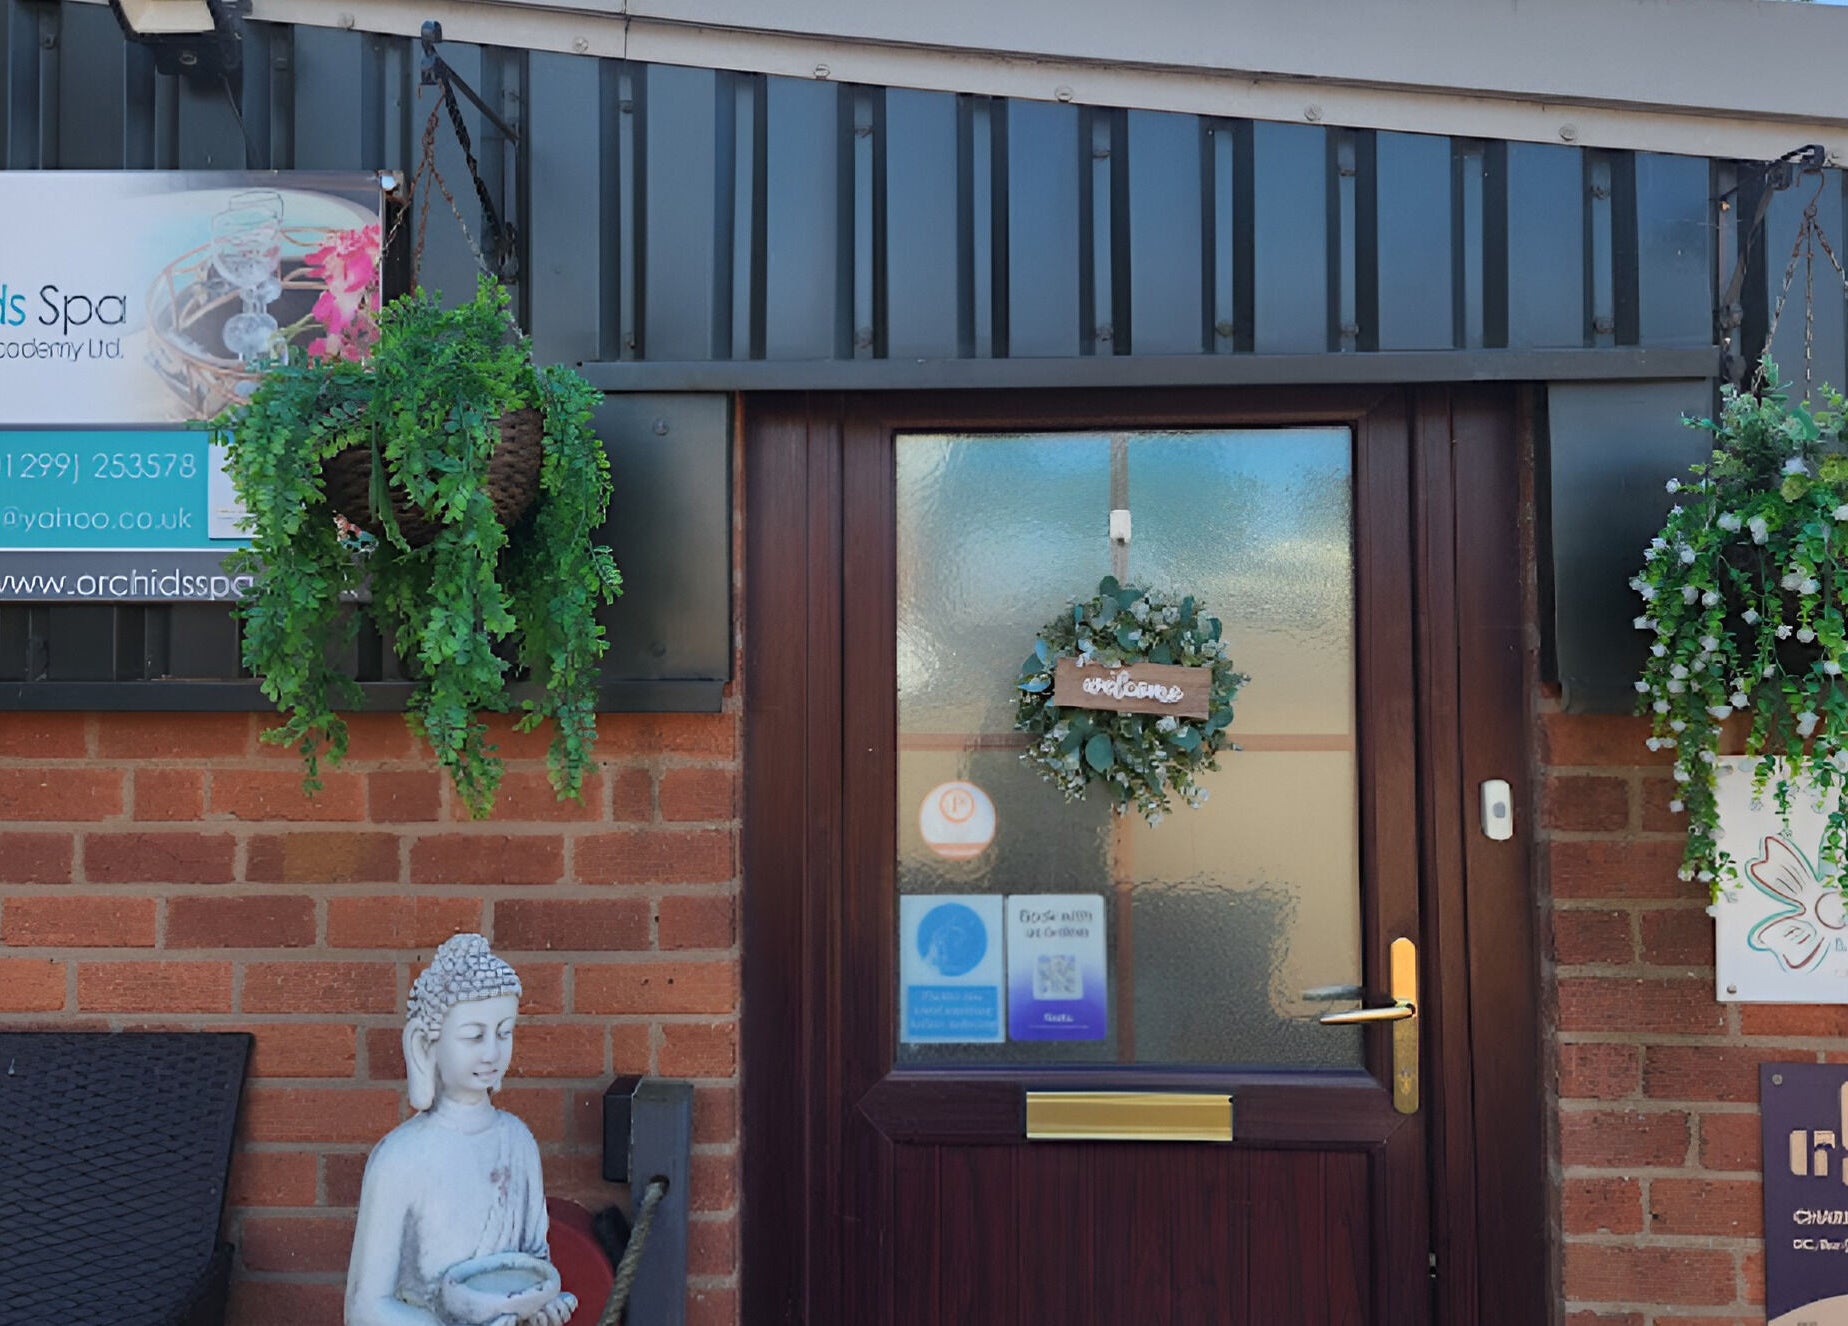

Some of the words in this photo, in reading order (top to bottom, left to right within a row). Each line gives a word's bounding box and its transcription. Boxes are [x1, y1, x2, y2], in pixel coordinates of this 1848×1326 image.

[39, 284, 127, 336] Spa
[92, 452, 196, 479] 253578
[3, 506, 192, 532] @yahoo.co.uk
